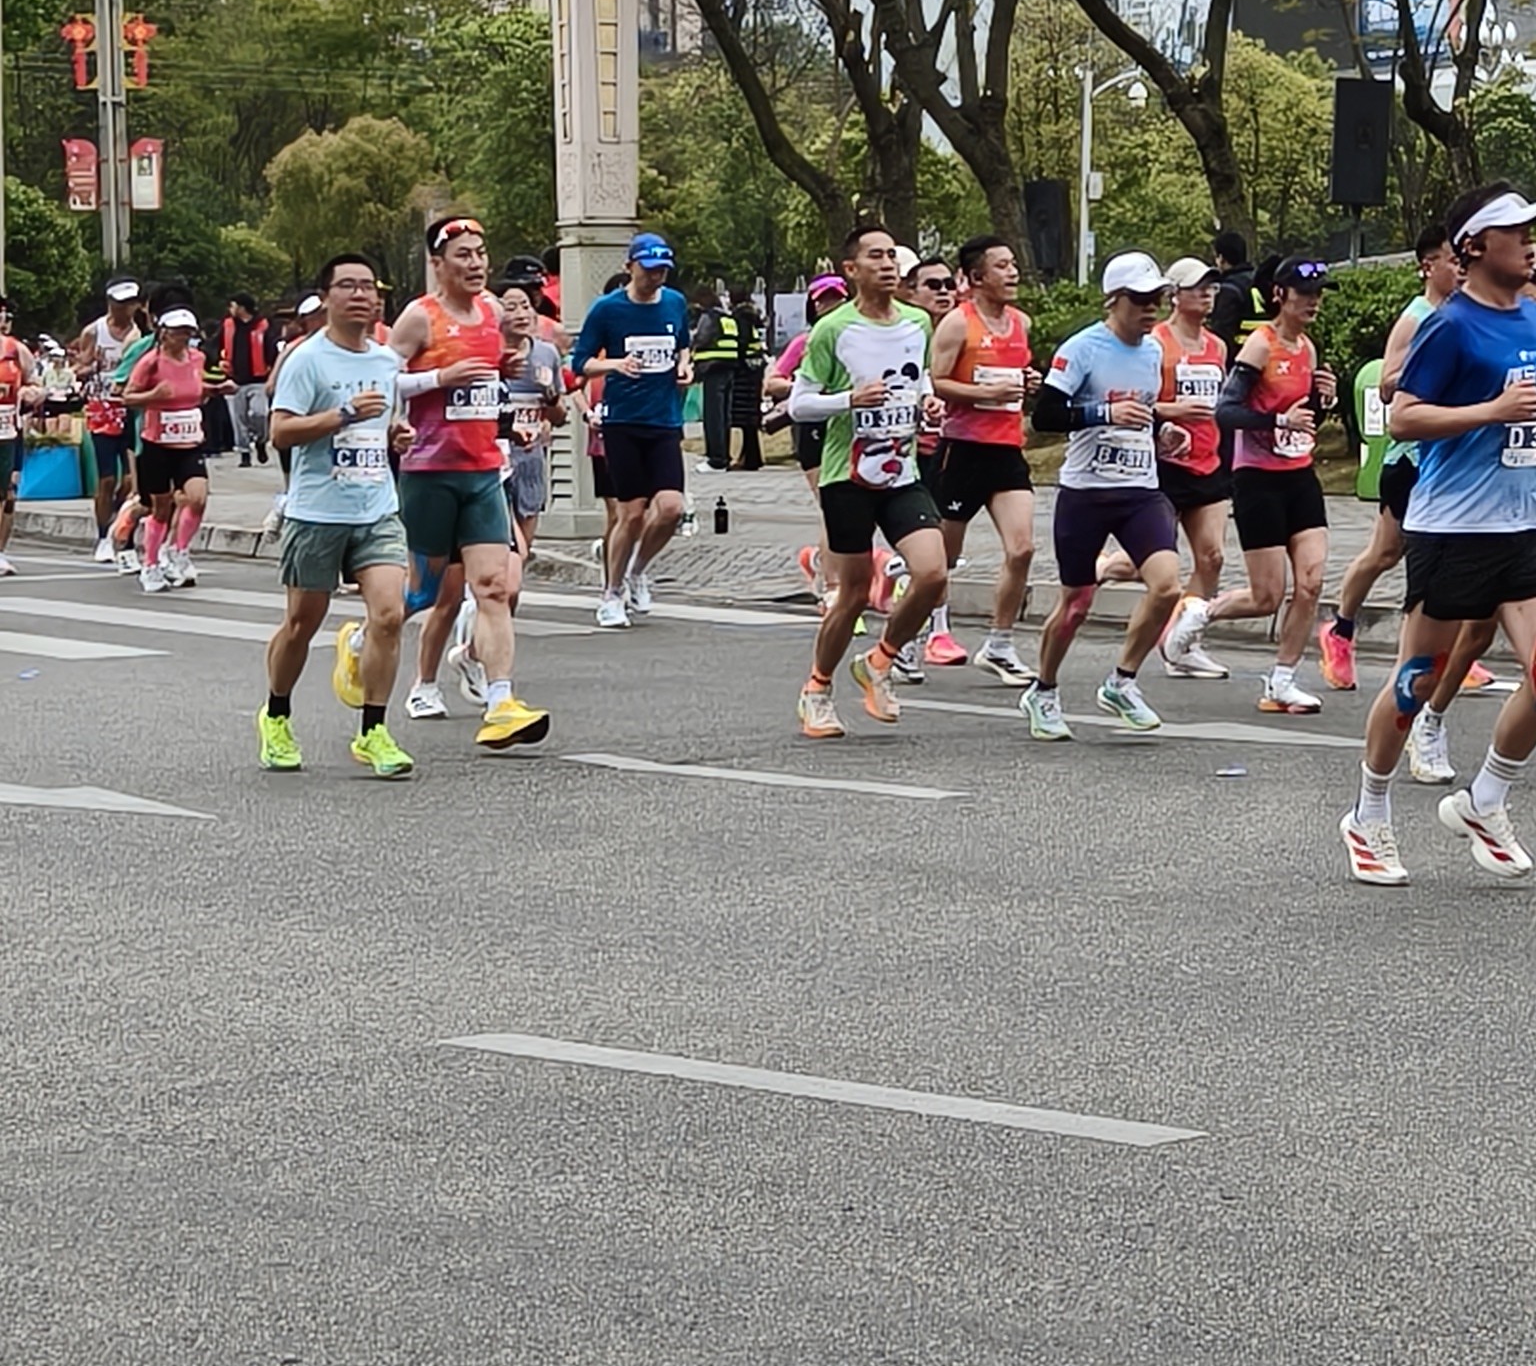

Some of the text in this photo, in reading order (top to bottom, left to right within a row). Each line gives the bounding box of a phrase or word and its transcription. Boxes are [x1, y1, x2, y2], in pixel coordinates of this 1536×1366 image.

[861, 411, 874, 427] D
[1508, 426, 1524, 448] D
[336, 448, 351, 467] C
